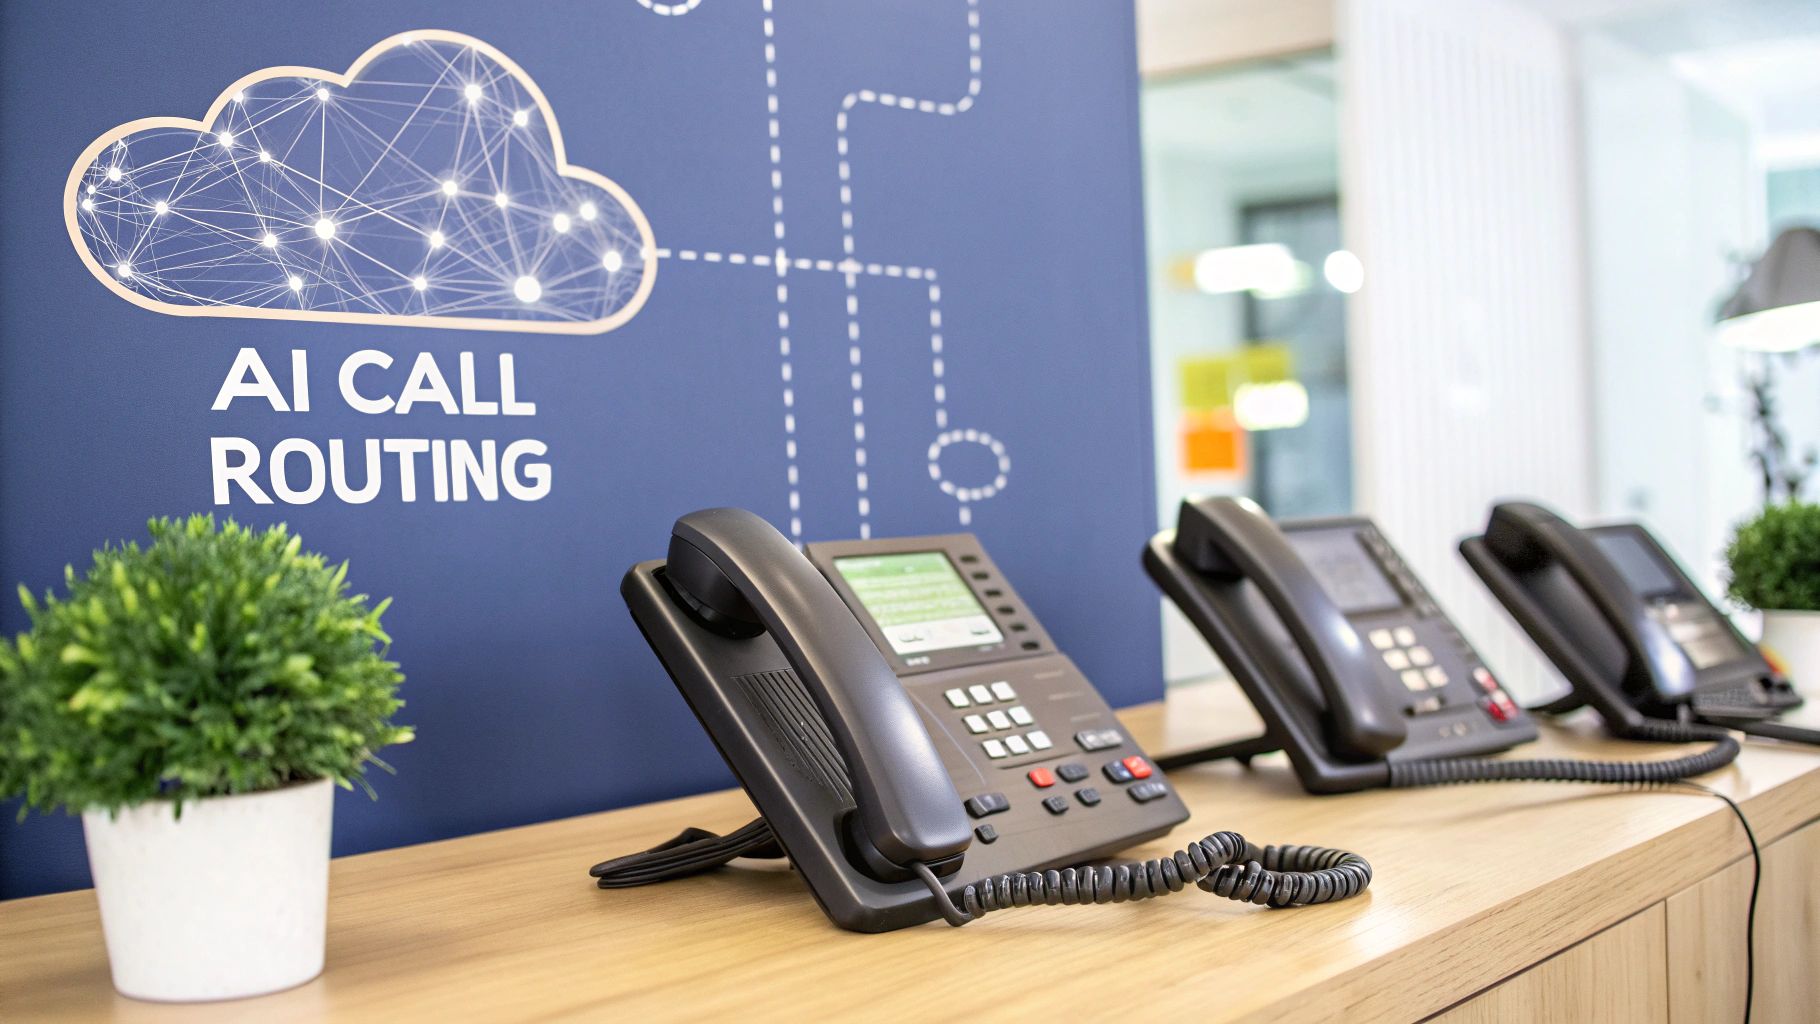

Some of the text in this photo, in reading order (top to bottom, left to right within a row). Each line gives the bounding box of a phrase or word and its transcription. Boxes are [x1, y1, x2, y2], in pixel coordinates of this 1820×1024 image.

[210, 347, 537, 416] AI CALL
[210, 436, 552, 505] ROUTING
